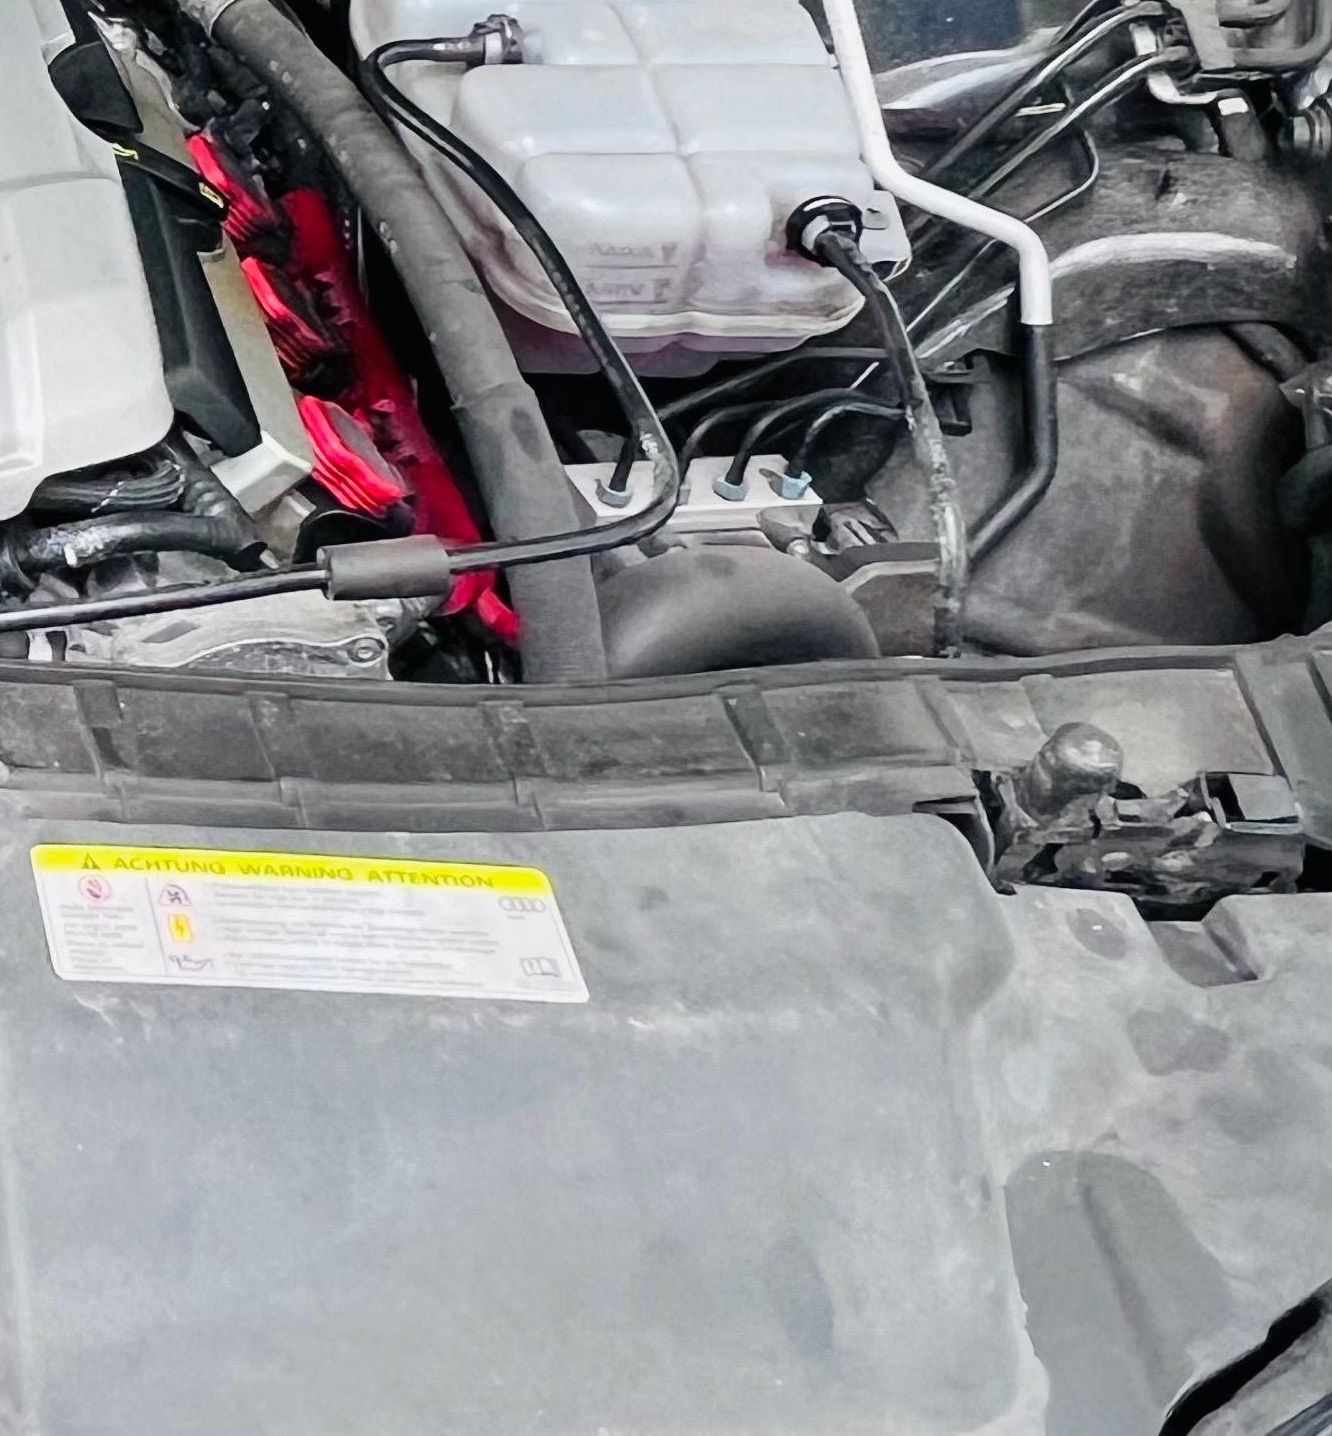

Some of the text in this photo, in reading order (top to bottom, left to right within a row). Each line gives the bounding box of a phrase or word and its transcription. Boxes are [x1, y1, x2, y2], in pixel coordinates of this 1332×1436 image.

[113, 857, 494, 889] ACHTUNG WARNING ATTENTION
